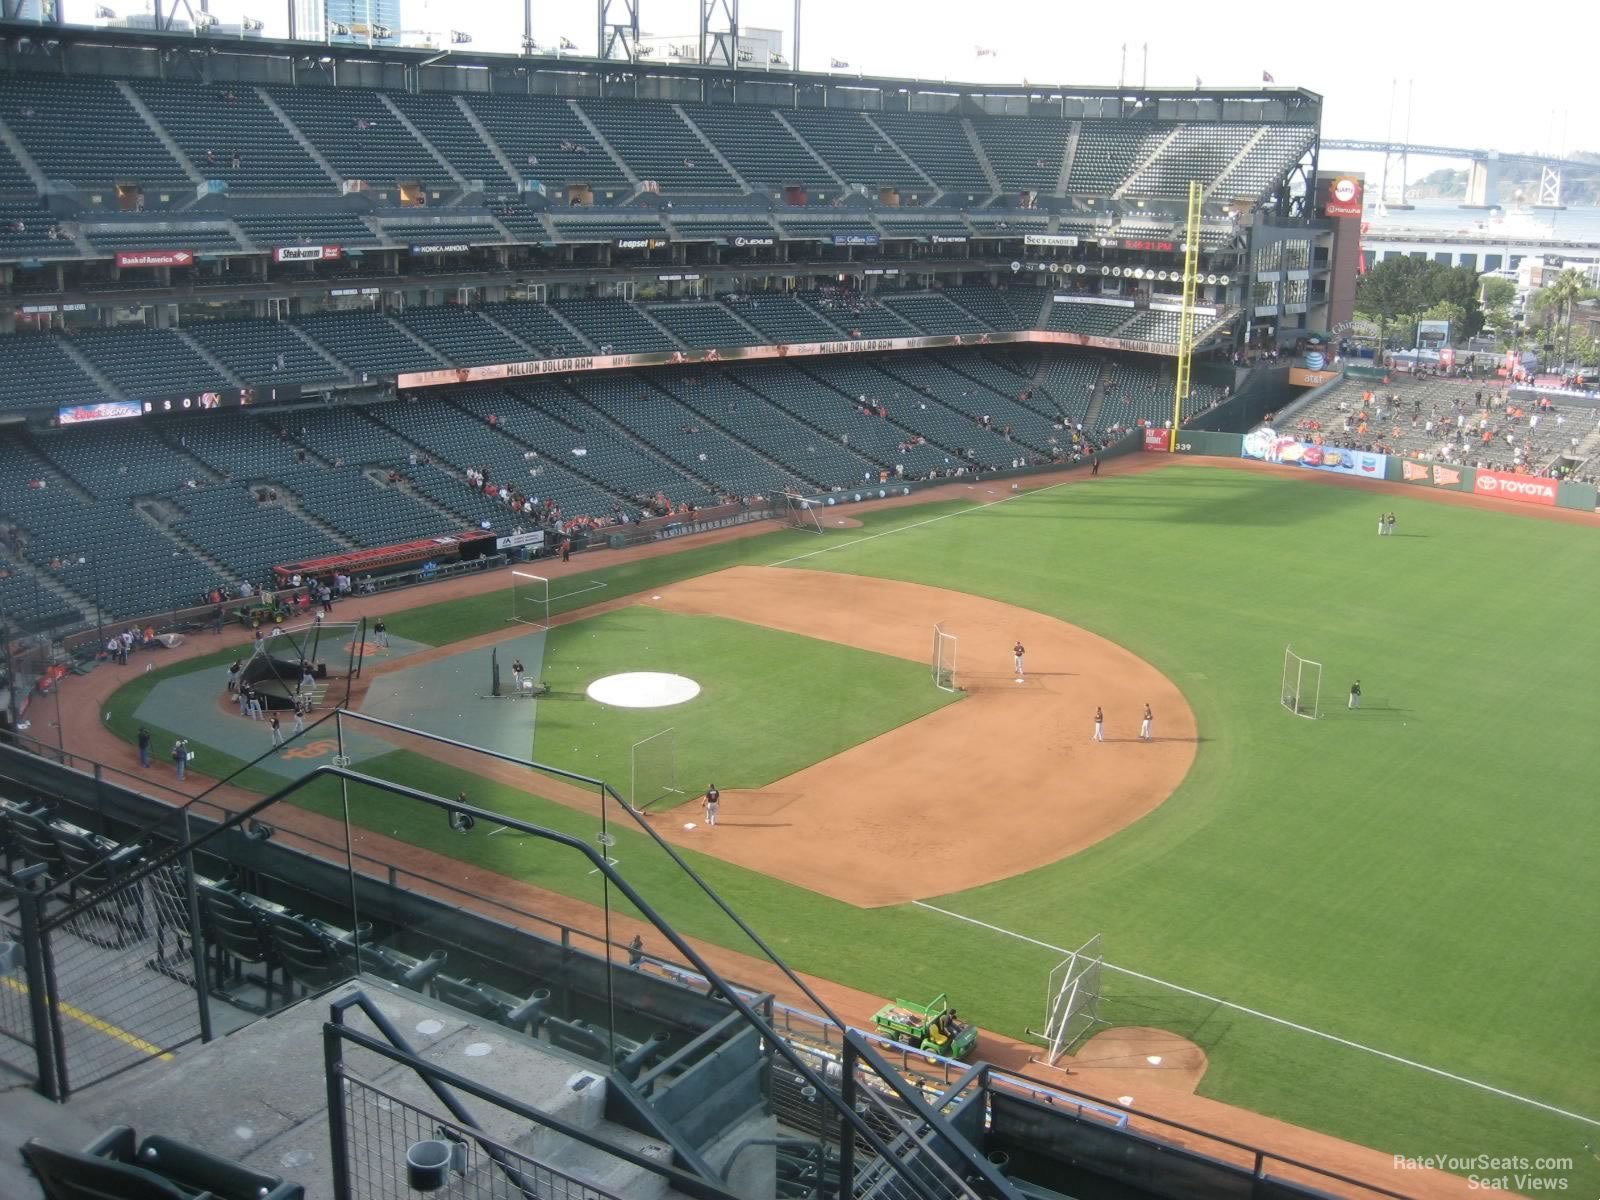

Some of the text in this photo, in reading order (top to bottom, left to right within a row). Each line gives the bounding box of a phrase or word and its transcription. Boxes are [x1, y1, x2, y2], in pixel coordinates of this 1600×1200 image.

[1026, 236, 1075, 246] See's CANDIES
[444, 244, 469, 252] MINOLTA
[122, 255, 173, 264] Bank of America
[820, 343, 849, 354] MILLION
[850, 340, 877, 352] DOLLAR
[877, 339, 893, 350] ARM
[1120, 339, 1149, 352] MILLION
[507, 360, 541, 376] MILLION
[542, 358, 573, 373] DOLLAR
[574, 357, 594, 370] ARM
[1304, 374, 1324, 383] at&t
[144, 402, 152, 412] B
[163, 401, 172, 410] S
[1175, 443, 1192, 451] 339
[1500, 479, 1554, 497] TOYOTA
